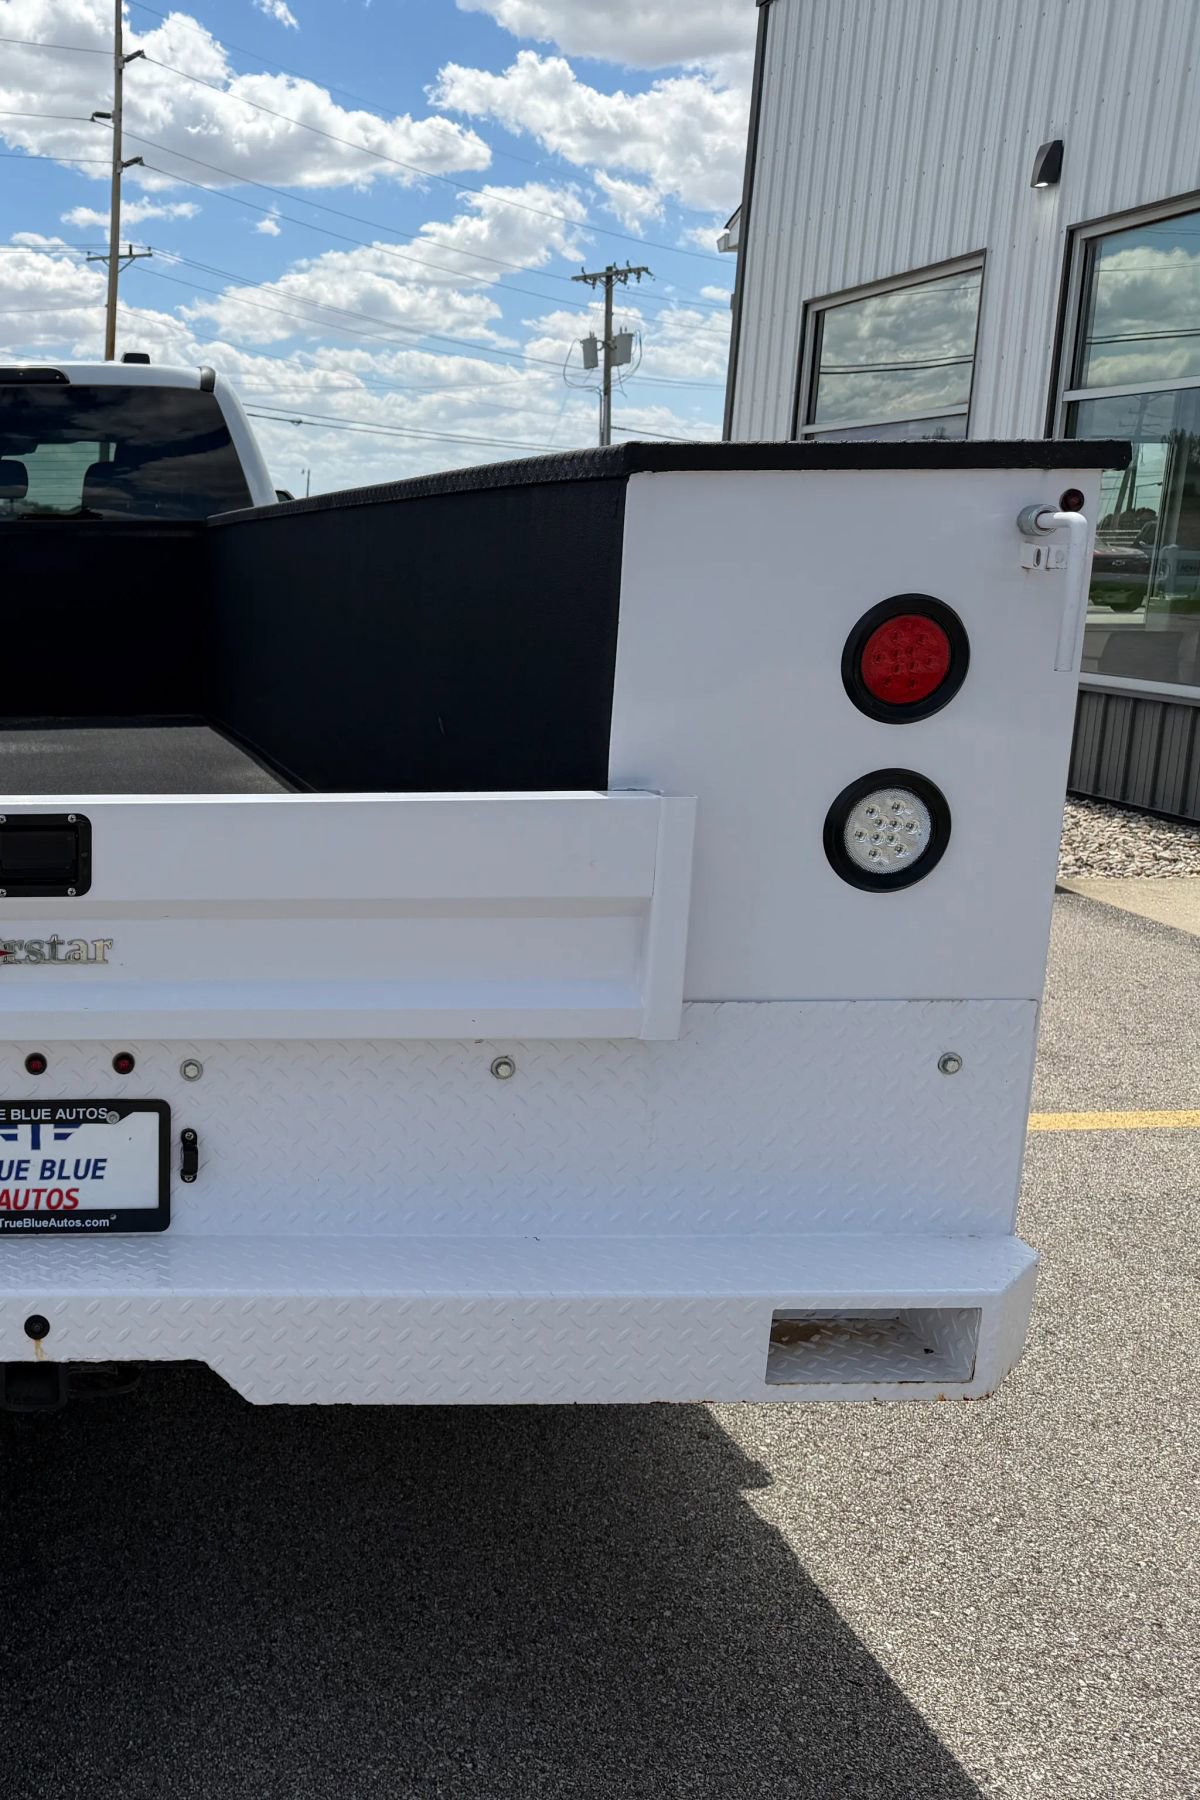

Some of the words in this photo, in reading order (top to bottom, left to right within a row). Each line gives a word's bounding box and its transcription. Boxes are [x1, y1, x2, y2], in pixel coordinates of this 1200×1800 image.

[11, 1108, 51, 1120] BLUE
[55, 1107, 108, 1120] AUTOS
[39, 1158, 107, 1181] BLUE
